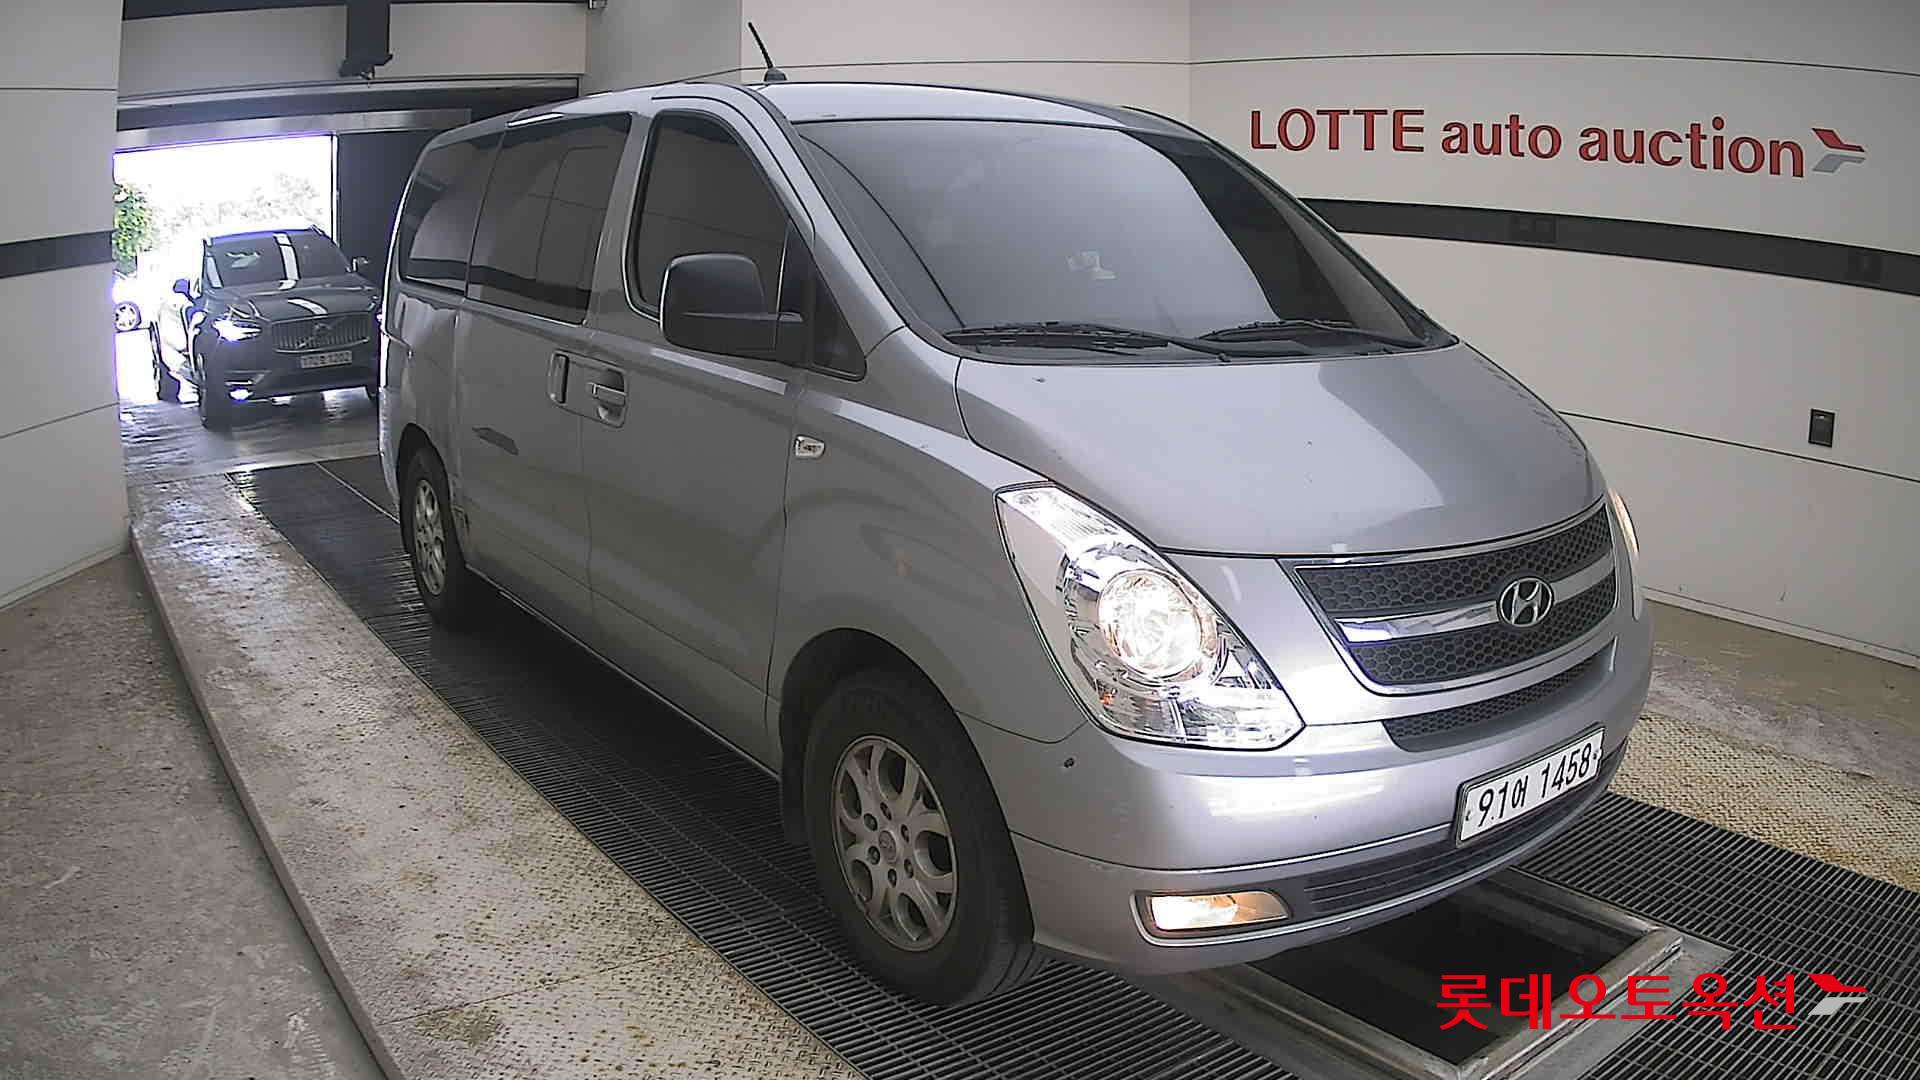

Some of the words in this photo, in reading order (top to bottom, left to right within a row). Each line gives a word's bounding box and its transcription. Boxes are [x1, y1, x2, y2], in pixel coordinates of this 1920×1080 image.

[1250, 108, 1425, 153] LOTTE
[1442, 114, 1564, 160] auto
[1579, 116, 1805, 178] auction
[1478, 775, 1529, 828] 91어
[1541, 743, 1592, 799] 1458
